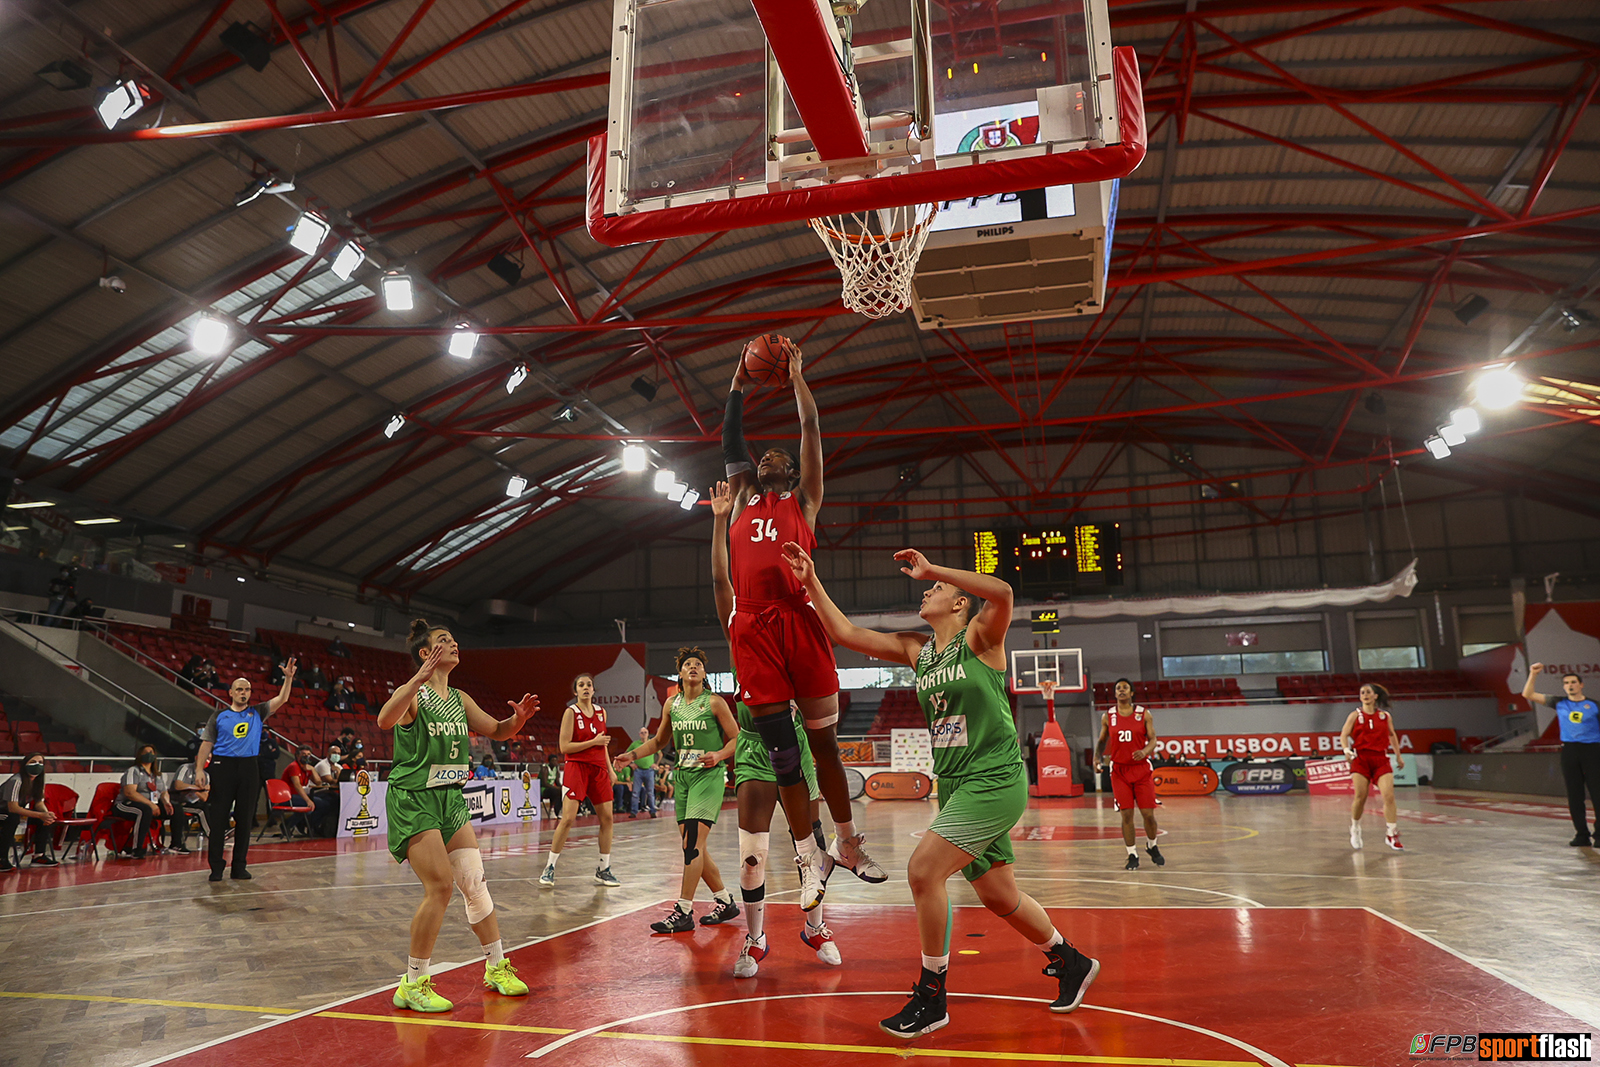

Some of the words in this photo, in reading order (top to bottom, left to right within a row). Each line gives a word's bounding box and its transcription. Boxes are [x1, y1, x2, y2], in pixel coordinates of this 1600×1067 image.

[976, 226, 1014, 238] PHILIPS
[750, 518, 778, 542] 34
[929, 690, 947, 714] 15
[237, 724, 245, 734] G
[590, 723, 597, 734] 4
[1368, 719, 1374, 730] 1
[682, 733, 694, 747] 13
[1118, 730, 1132, 743] 20
[449, 741, 460, 759] 5
[1145, 739, 1210, 755] PORT
[1216, 737, 1293, 754] LISBOA
[1299, 737, 1311, 751] E
[1247, 768, 1285, 782] FPB
